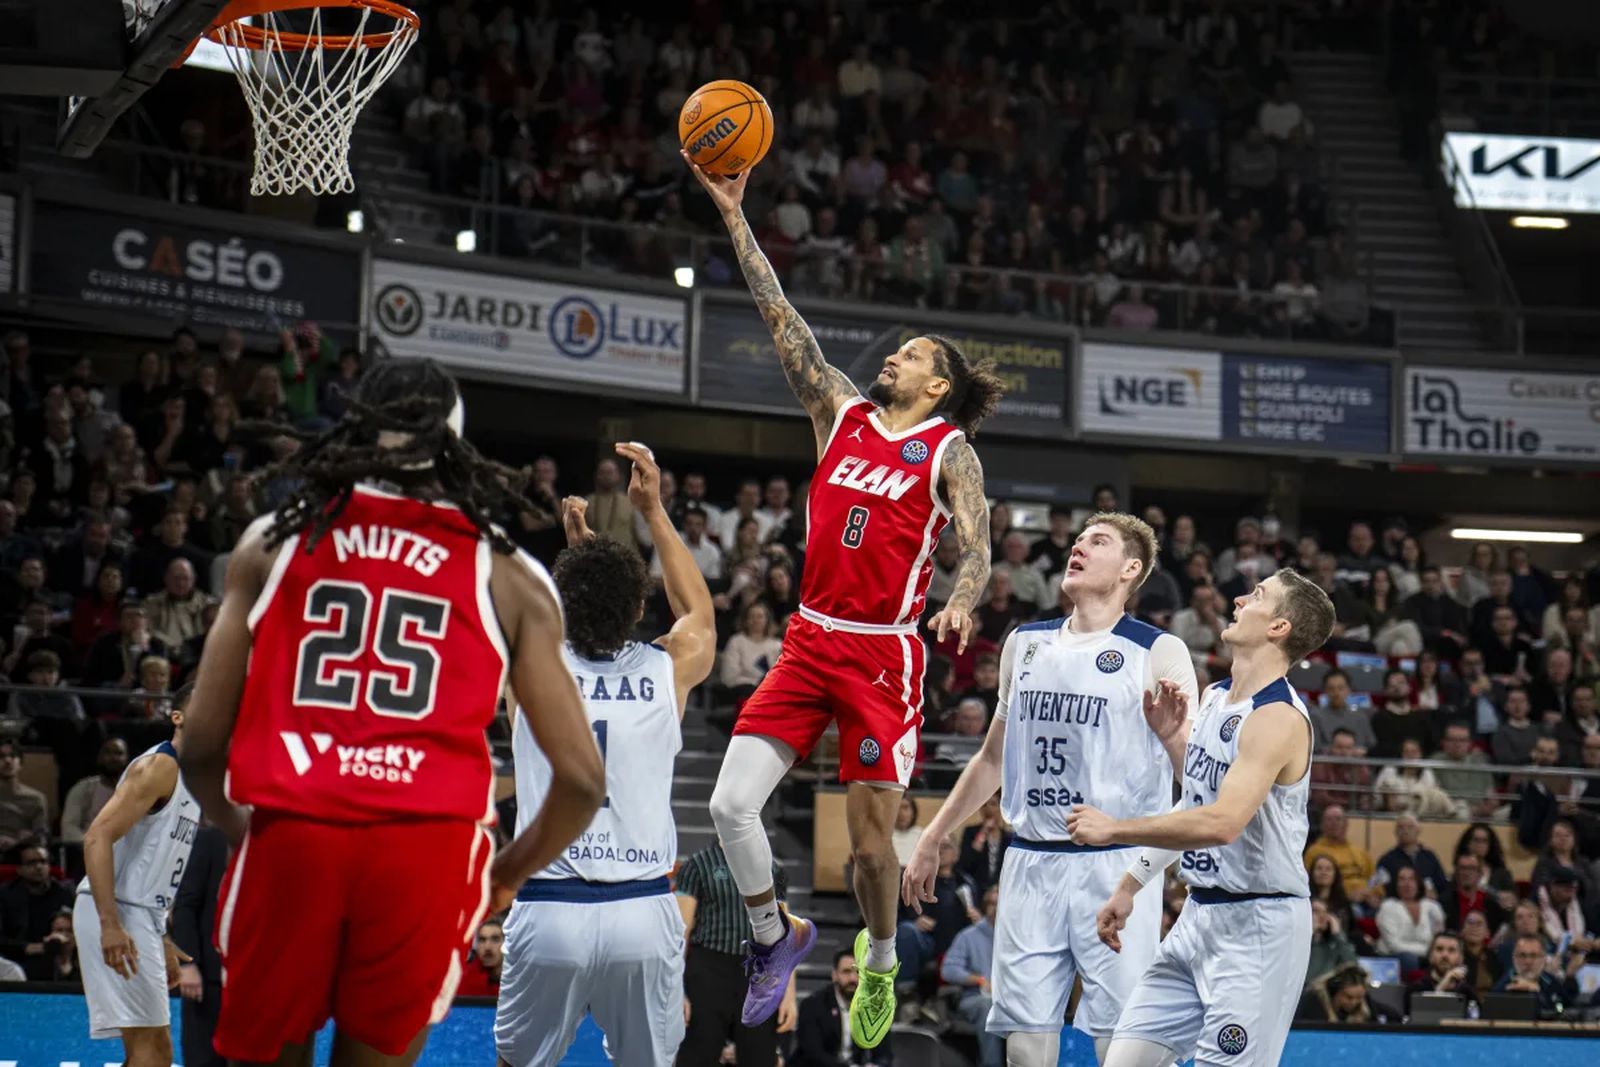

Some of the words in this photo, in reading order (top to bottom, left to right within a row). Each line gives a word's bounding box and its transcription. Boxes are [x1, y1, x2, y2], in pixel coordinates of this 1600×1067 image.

[688, 117, 738, 156] Wilson
[112, 228, 283, 292] CASÉO
[429, 290, 543, 333] JARDI
[1113, 375, 1188, 407] NGE
[1412, 417, 1541, 454] Thalie
[827, 455, 920, 501] ELAN
[841, 505, 870, 549] 8
[332, 525, 450, 577] MUTTS
[292, 578, 451, 721] 25
[336, 745, 426, 772] VICKY
[338, 763, 413, 784] FOODS
[1035, 736, 1067, 776] 35
[569, 846, 659, 864] BADALONA
[598, 831, 611, 843] of
